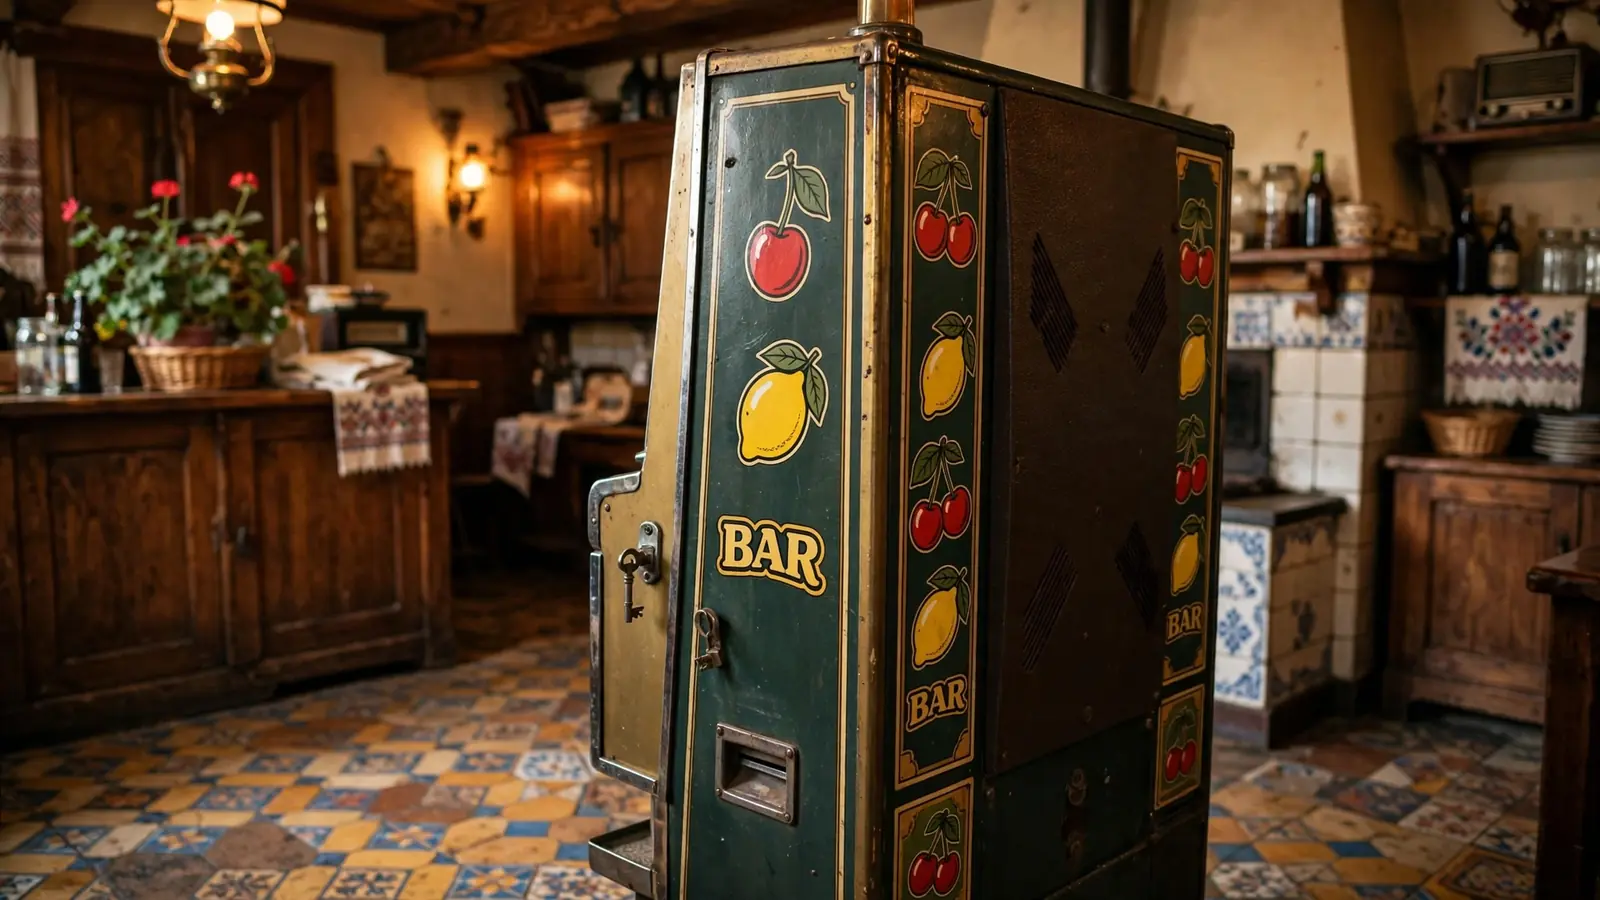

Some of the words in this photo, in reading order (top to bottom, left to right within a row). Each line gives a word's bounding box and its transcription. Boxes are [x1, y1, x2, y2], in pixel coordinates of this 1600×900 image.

[721, 523, 820, 587] BAR
[1167, 605, 1202, 640] BAR
[909, 679, 965, 726] BAR
